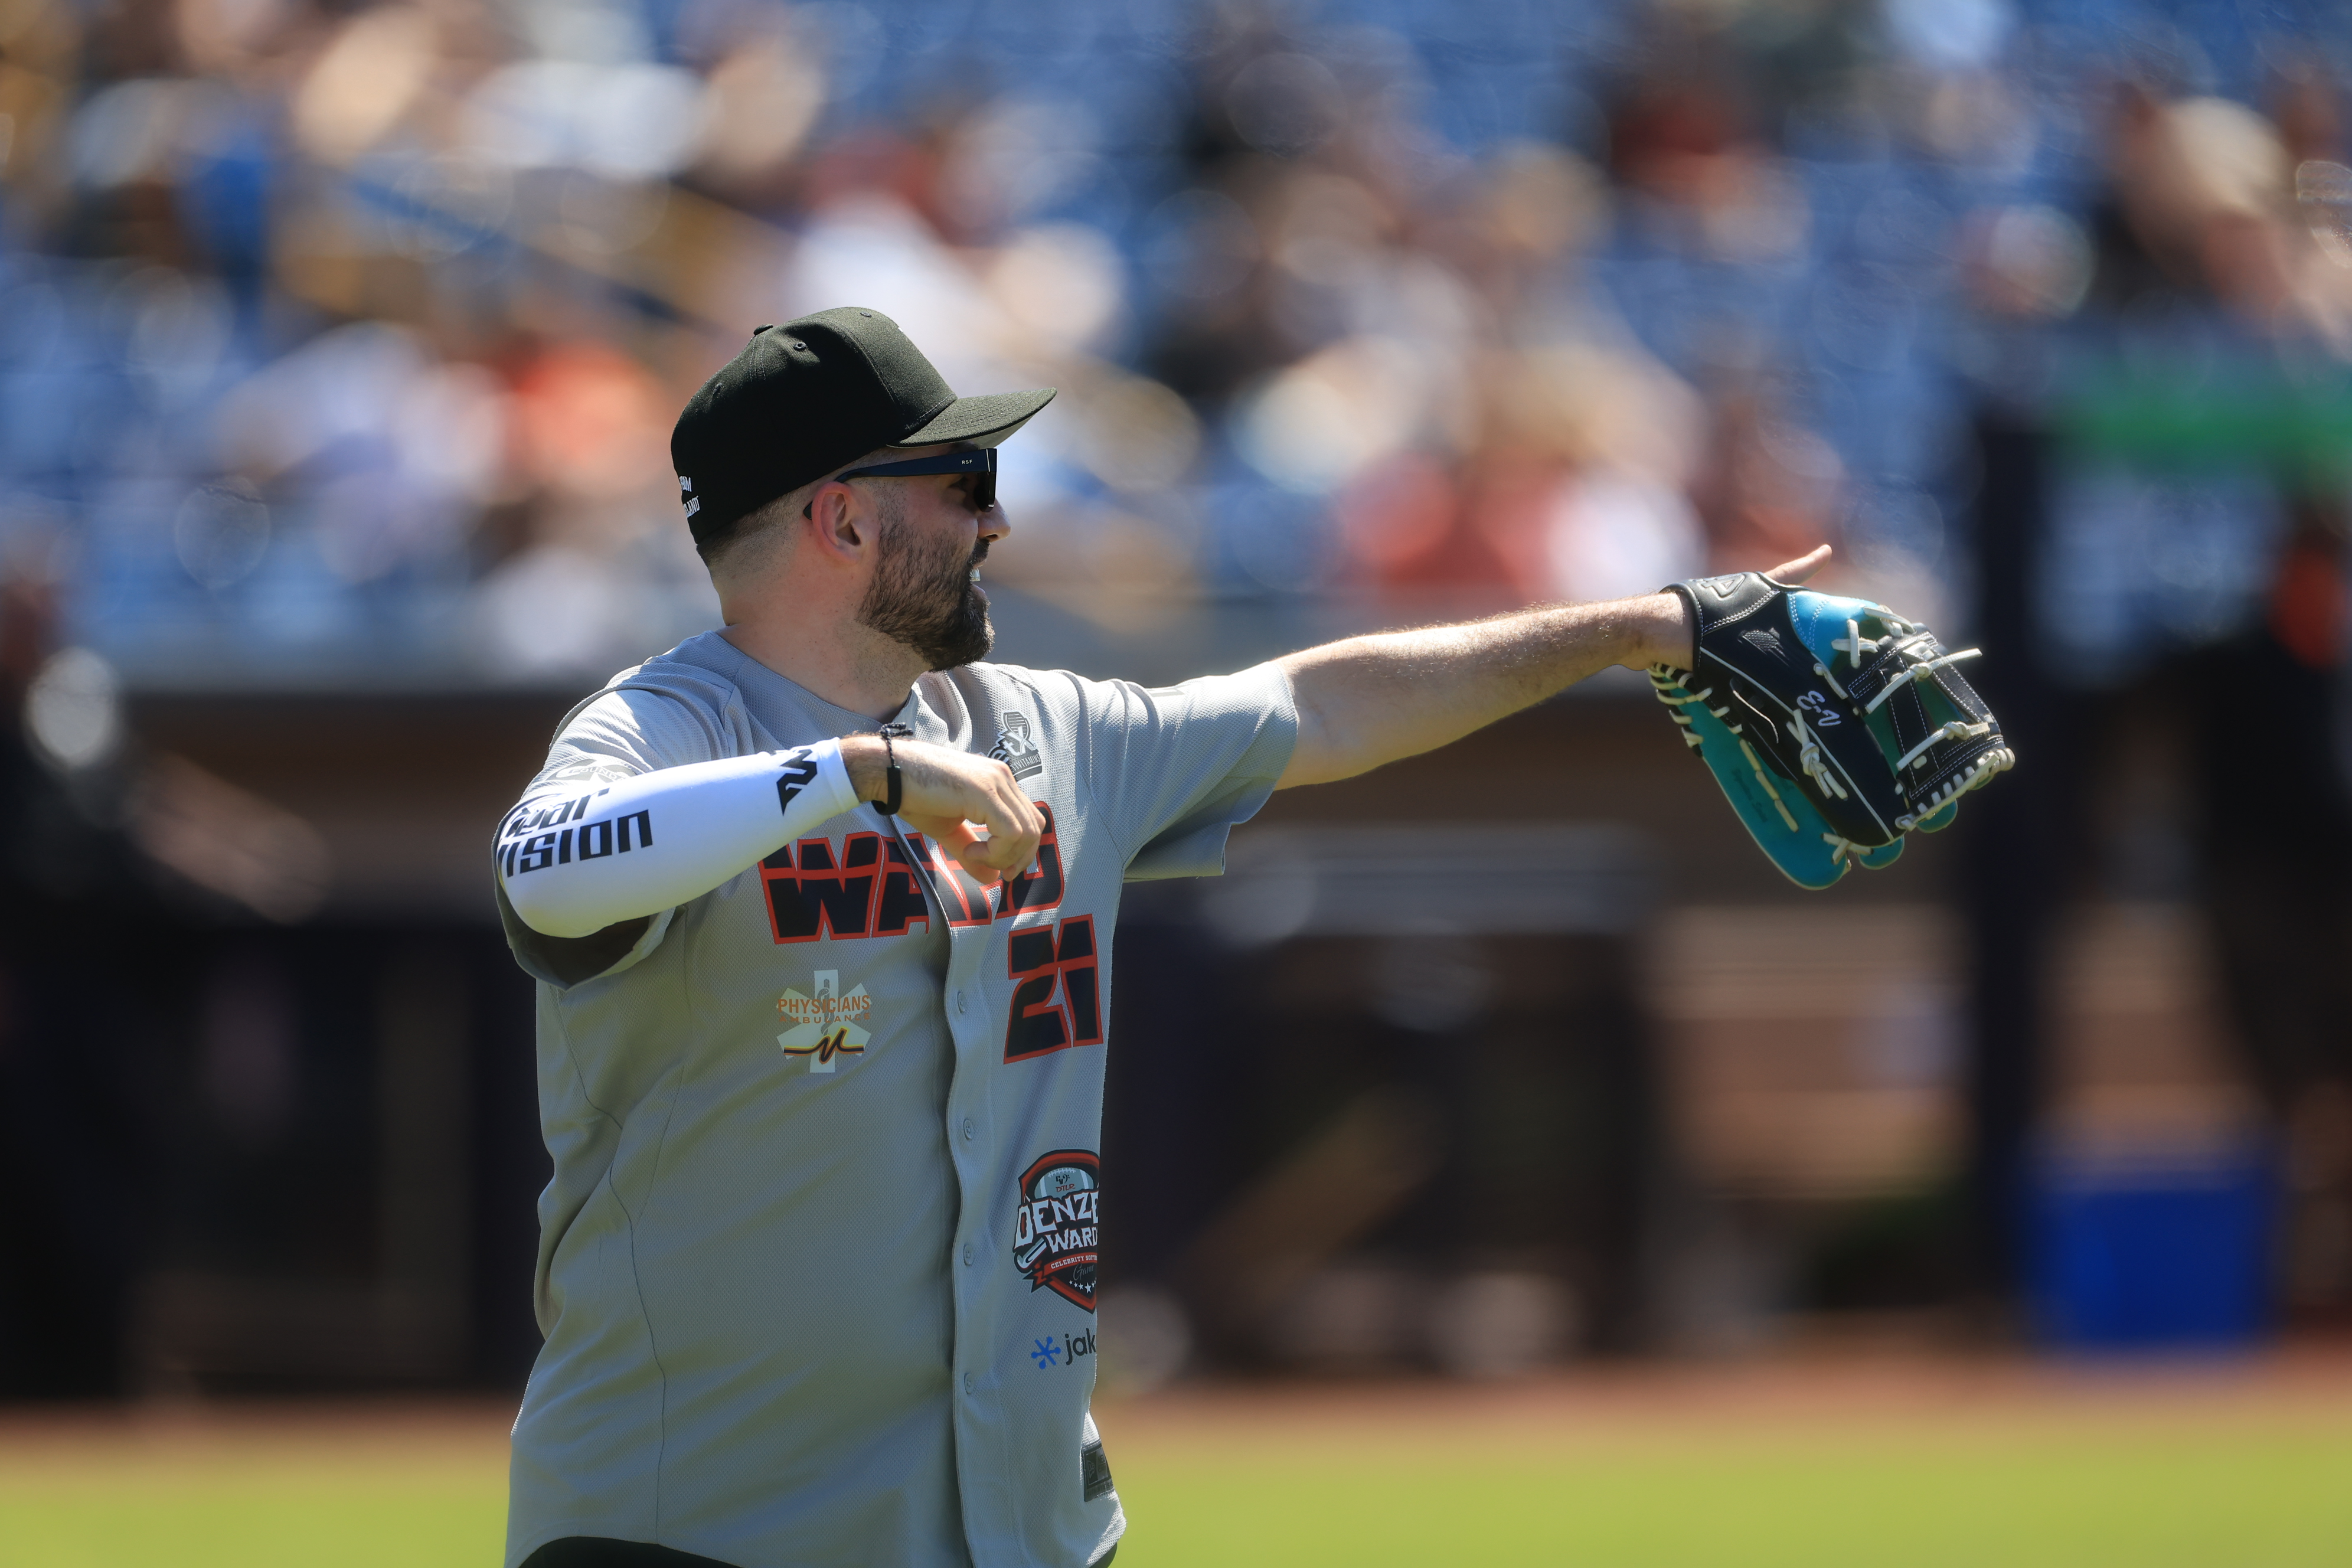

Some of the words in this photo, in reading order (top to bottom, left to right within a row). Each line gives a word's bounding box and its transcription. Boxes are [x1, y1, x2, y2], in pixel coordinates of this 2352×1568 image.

[1004, 913, 1104, 1065] 21
[778, 994, 871, 1014] PHYSICIANS
[779, 1012, 871, 1024] AMBULANCE
[1055, 1183, 1076, 1193] DTLR
[1044, 1226, 1098, 1254] WARD
[1050, 1255, 1084, 1269] CELEBRITY
[1064, 1328, 1096, 1366] jak
